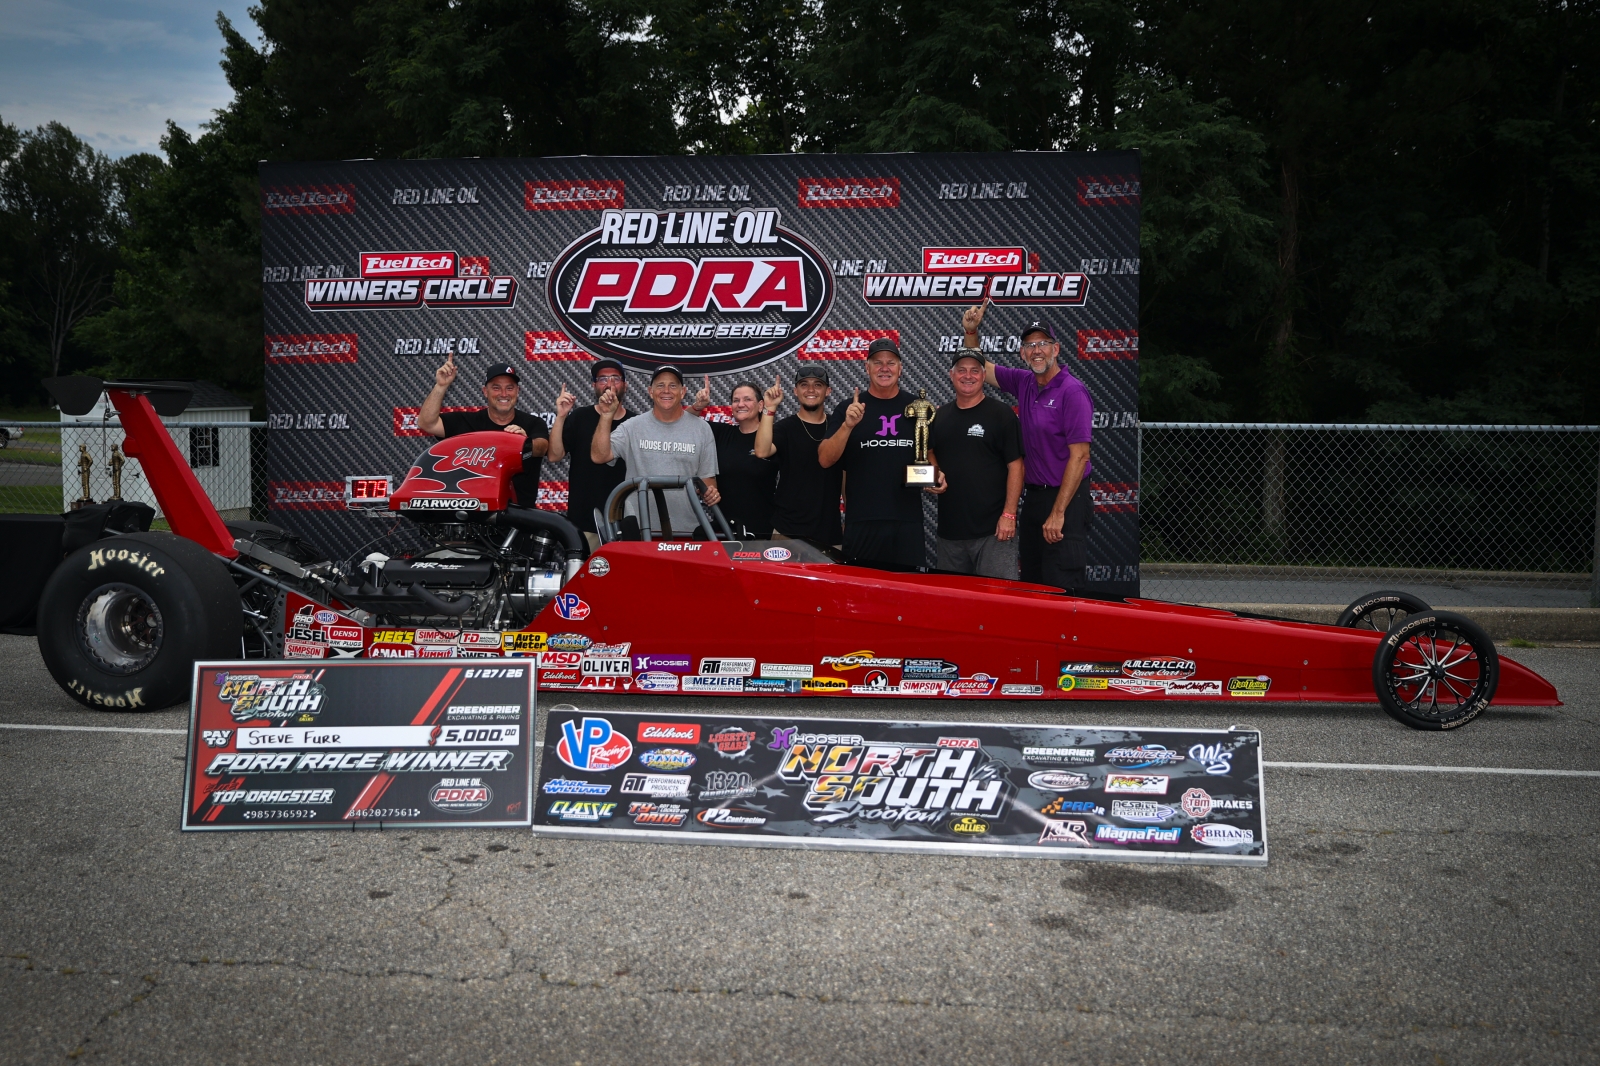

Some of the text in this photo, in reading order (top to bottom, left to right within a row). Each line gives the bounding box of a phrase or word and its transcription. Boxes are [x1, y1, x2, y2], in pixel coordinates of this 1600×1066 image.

[392, 187, 480, 204] RED LINE OIL
[533, 187, 618, 203] FuelTech
[662, 184, 751, 201] RED LINE OIL
[806, 184, 892, 200] FuelTech
[939, 182, 1029, 199] RED LINE OIL
[266, 191, 348, 208] FuelTech
[601, 211, 778, 244] RED LINE OIL
[365, 256, 453, 274] FuelTech
[928, 252, 1020, 269] FuelTech
[1080, 259, 1109, 275] RED
[263, 267, 289, 282] RED
[307, 278, 509, 302] WINNERS CIRCLE
[568, 257, 807, 312] PDRA
[866, 275, 1080, 297] WINNERS CIRCLE
[589, 324, 789, 338] DRAG RACING SERIES
[270, 341, 351, 357] FuelTech
[395, 338, 480, 354] RED LINE OIL
[269, 413, 350, 429] RED LINE OIL
[639, 439, 661, 451] HOUSE
[663, 441, 672, 451] OF
[673, 442, 695, 454] PAYNE
[860, 439, 914, 448] HOOSIER
[412, 499, 479, 509] HARWOOD
[657, 543, 702, 551] Steve Furr
[733, 551, 761, 559] PDRA
[765, 550, 790, 559] NHRA
[88, 547, 165, 577] Hoosier
[556, 594, 579, 619] VP
[1361, 596, 1400, 608] HOOSIER
[317, 613, 335, 621] NHRA
[1397, 616, 1436, 637] HOOSIER
[286, 628, 328, 642] JESEL
[332, 630, 358, 638] DENSO
[374, 631, 415, 643] JEG'S
[418, 631, 456, 640] SIMPSON
[516, 634, 541, 642] Auto
[287, 645, 320, 656] SIMPSON
[514, 641, 546, 651] Meter
[372, 648, 415, 658] AMALIE
[542, 652, 581, 664] MSD
[583, 660, 629, 673] OLIVER
[702, 661, 721, 674] ATI
[1123, 660, 1195, 669] AMERICAN
[465, 669, 524, 678] 6/27/26
[543, 671, 576, 680] Edelbrock
[1132, 669, 1180, 677] Race Cars
[221, 680, 310, 695] NORTH
[580, 676, 633, 690] ARP
[692, 677, 742, 686] MEZIERE
[801, 680, 846, 688] Milodon
[903, 682, 943, 690] SIMPSON
[1108, 679, 1169, 687] COMPUTECH
[68, 680, 146, 709] Hoosier
[234, 695, 321, 711] SOUTH
[447, 705, 521, 714] GREENBRIER
[1441, 704, 1483, 729] HOOSIER
[202, 730, 230, 738] PAY
[248, 731, 294, 745] STEVE
[642, 726, 694, 739] Edelbrock
[708, 731, 756, 743] LIBERTY'S
[561, 717, 613, 769] VP
[718, 741, 748, 751] GEARS
[793, 734, 862, 745] HOOSIER
[937, 738, 980, 748] PDRA
[592, 745, 631, 763] Racing
[1023, 747, 1095, 757] GREENBRIER
[1113, 750, 1175, 759] SWITZER
[208, 750, 509, 771] PDRA RACE WINNER
[782, 745, 975, 779] NORTH
[441, 778, 482, 786] RED LINE OIL
[623, 775, 647, 791] ATI
[705, 770, 752, 791] 1320
[213, 788, 335, 804] TOP DRAGSTER
[434, 789, 487, 802] PDRA
[545, 786, 610, 794] WILLIAMS
[808, 775, 1002, 810] SOUTH
[1062, 801, 1095, 811] PRP
[1092, 806, 1106, 815] JR
[1189, 798, 1253, 809] TBM BRAKES
[251, 810, 308, 818] 985736592
[350, 808, 414, 816] 8462027561
[636, 813, 684, 824] DRIVE
[703, 808, 767, 824] P2 Contracting
[954, 823, 986, 833] CALLIES
[1097, 826, 1178, 842] MagnaFuel
